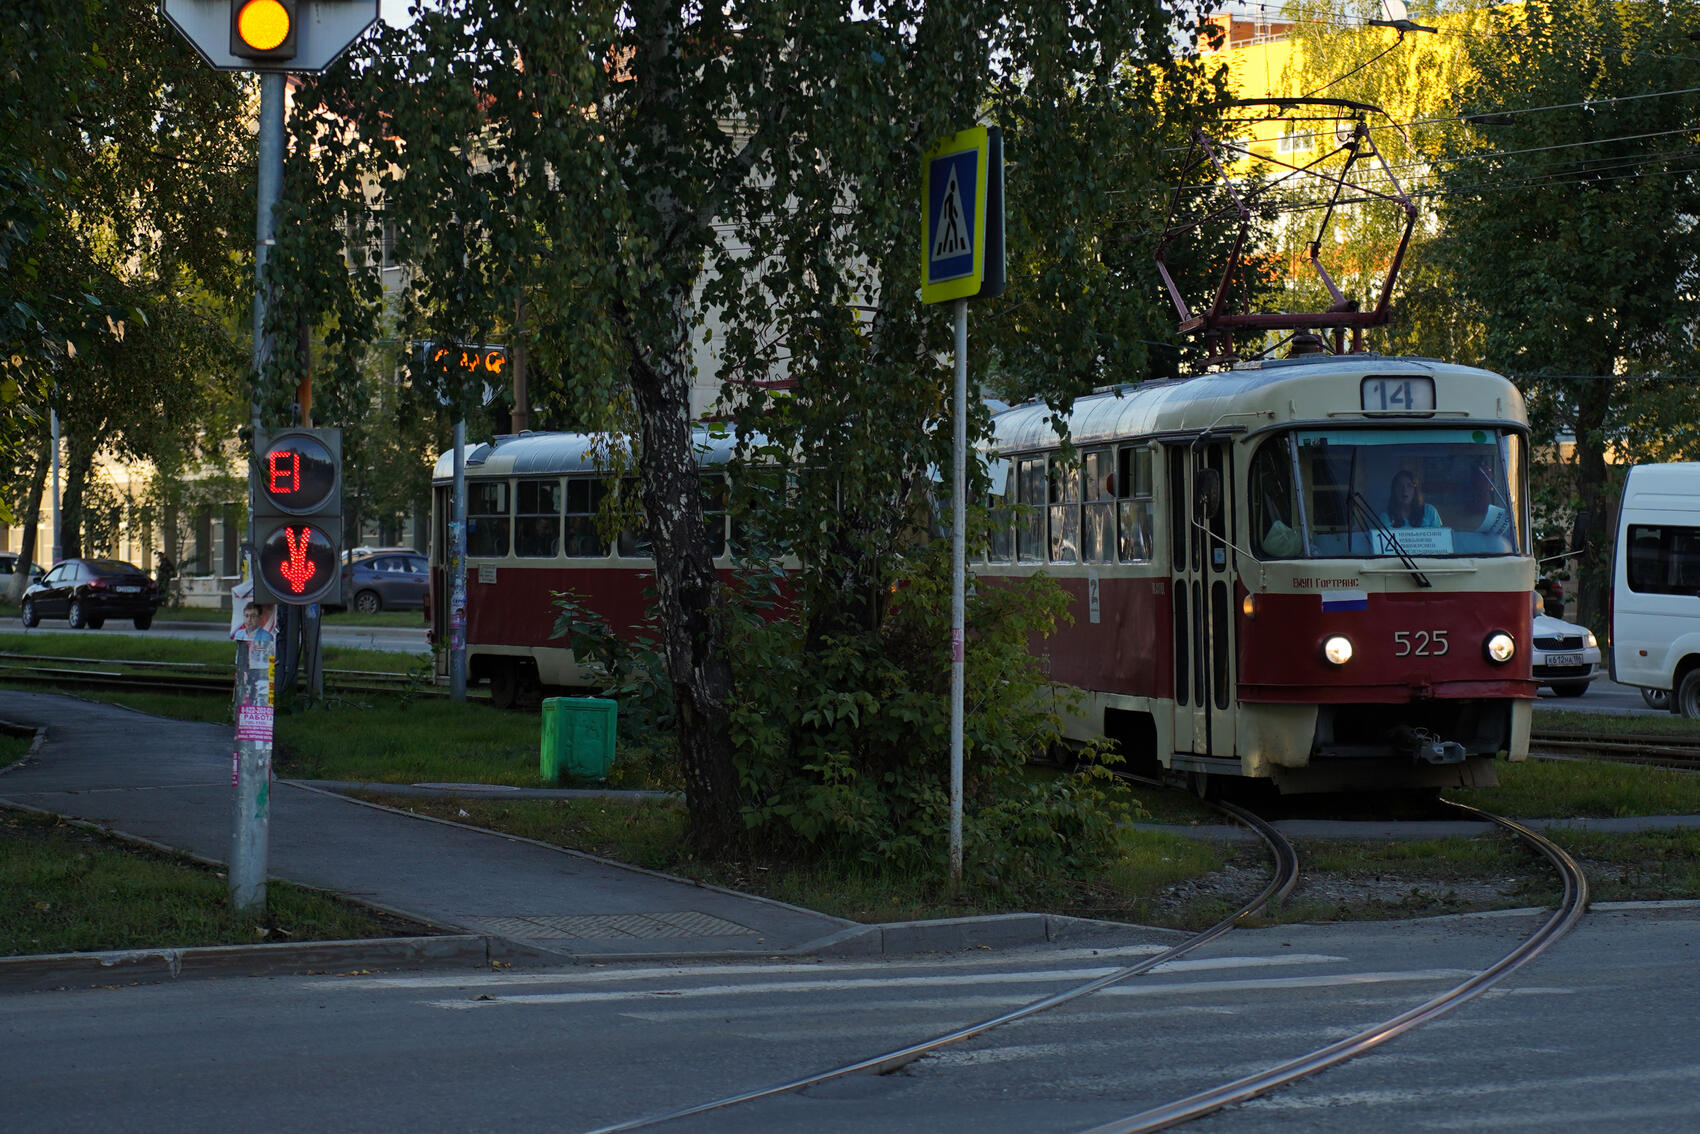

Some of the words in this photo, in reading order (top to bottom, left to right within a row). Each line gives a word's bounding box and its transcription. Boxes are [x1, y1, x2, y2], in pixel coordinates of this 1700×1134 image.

[1373, 381, 1414, 410] 14
[1394, 630, 1449, 657] 525
[243, 713, 273, 722] РАБОТА
